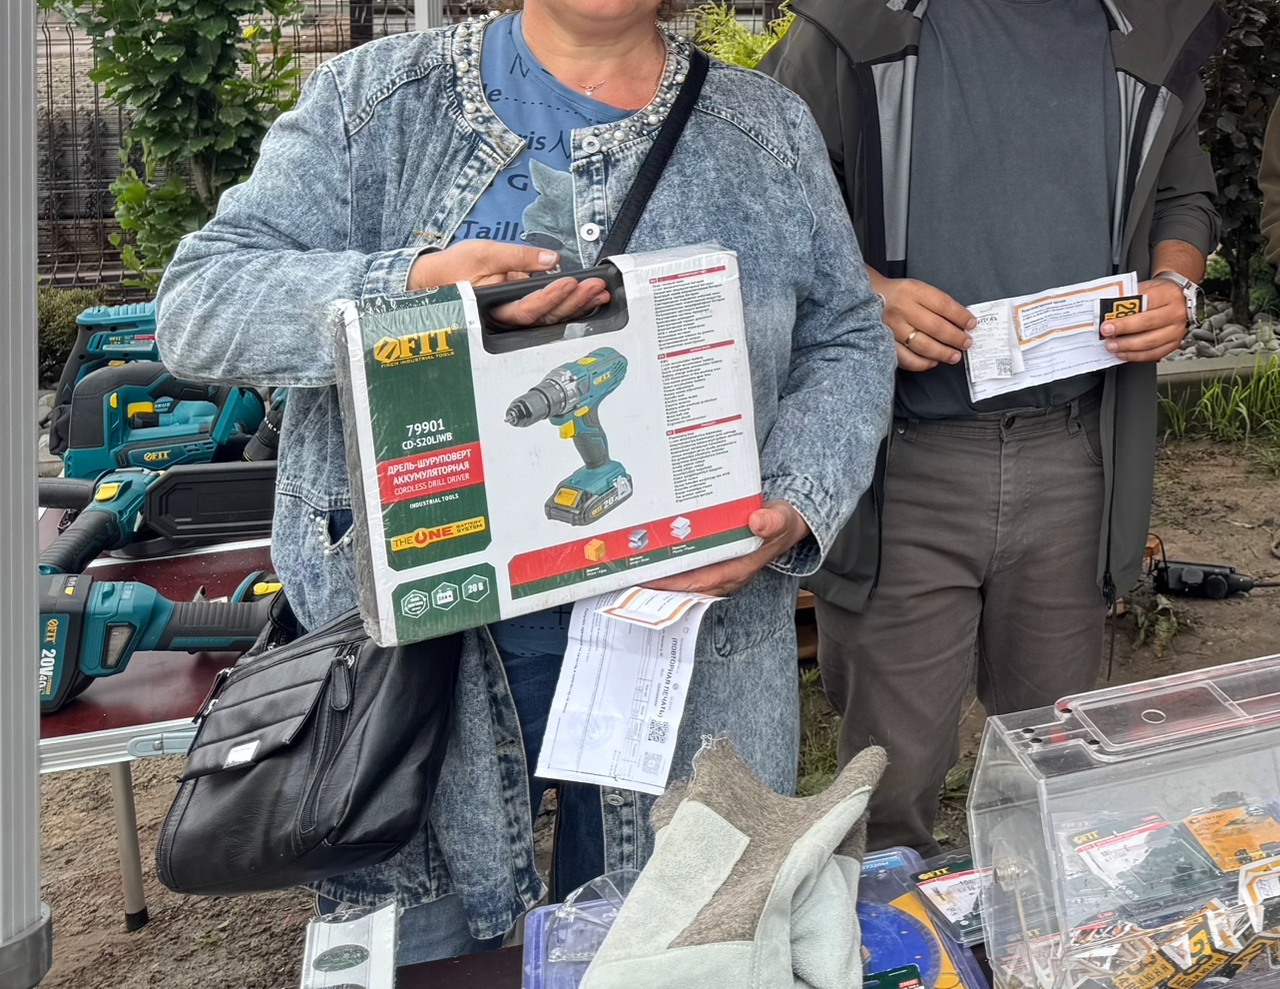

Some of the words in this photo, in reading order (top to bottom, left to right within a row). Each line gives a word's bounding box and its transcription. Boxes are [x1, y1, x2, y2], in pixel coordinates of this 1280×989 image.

[462, 219, 525, 241] Taill
[400, 355, 435, 366] INDUSTRIAL
[435, 351, 455, 359] TOOLS
[406, 418, 445, 437] 79901
[387, 449, 472, 475] ДРЕЛЬ-ШУРУПОВЕРТ
[393, 461, 470, 485] АККУМУЛЯТОРНАЯ
[394, 482, 427, 496] CORDLESS
[428, 478, 447, 490] DRILL
[448, 473, 470, 486] DRIVER
[410, 498, 442, 510] INDUSTRIAL
[442, 493, 459, 504] TOOLS
[392, 535, 414, 548] THE
[414, 526, 454, 544] ONE
